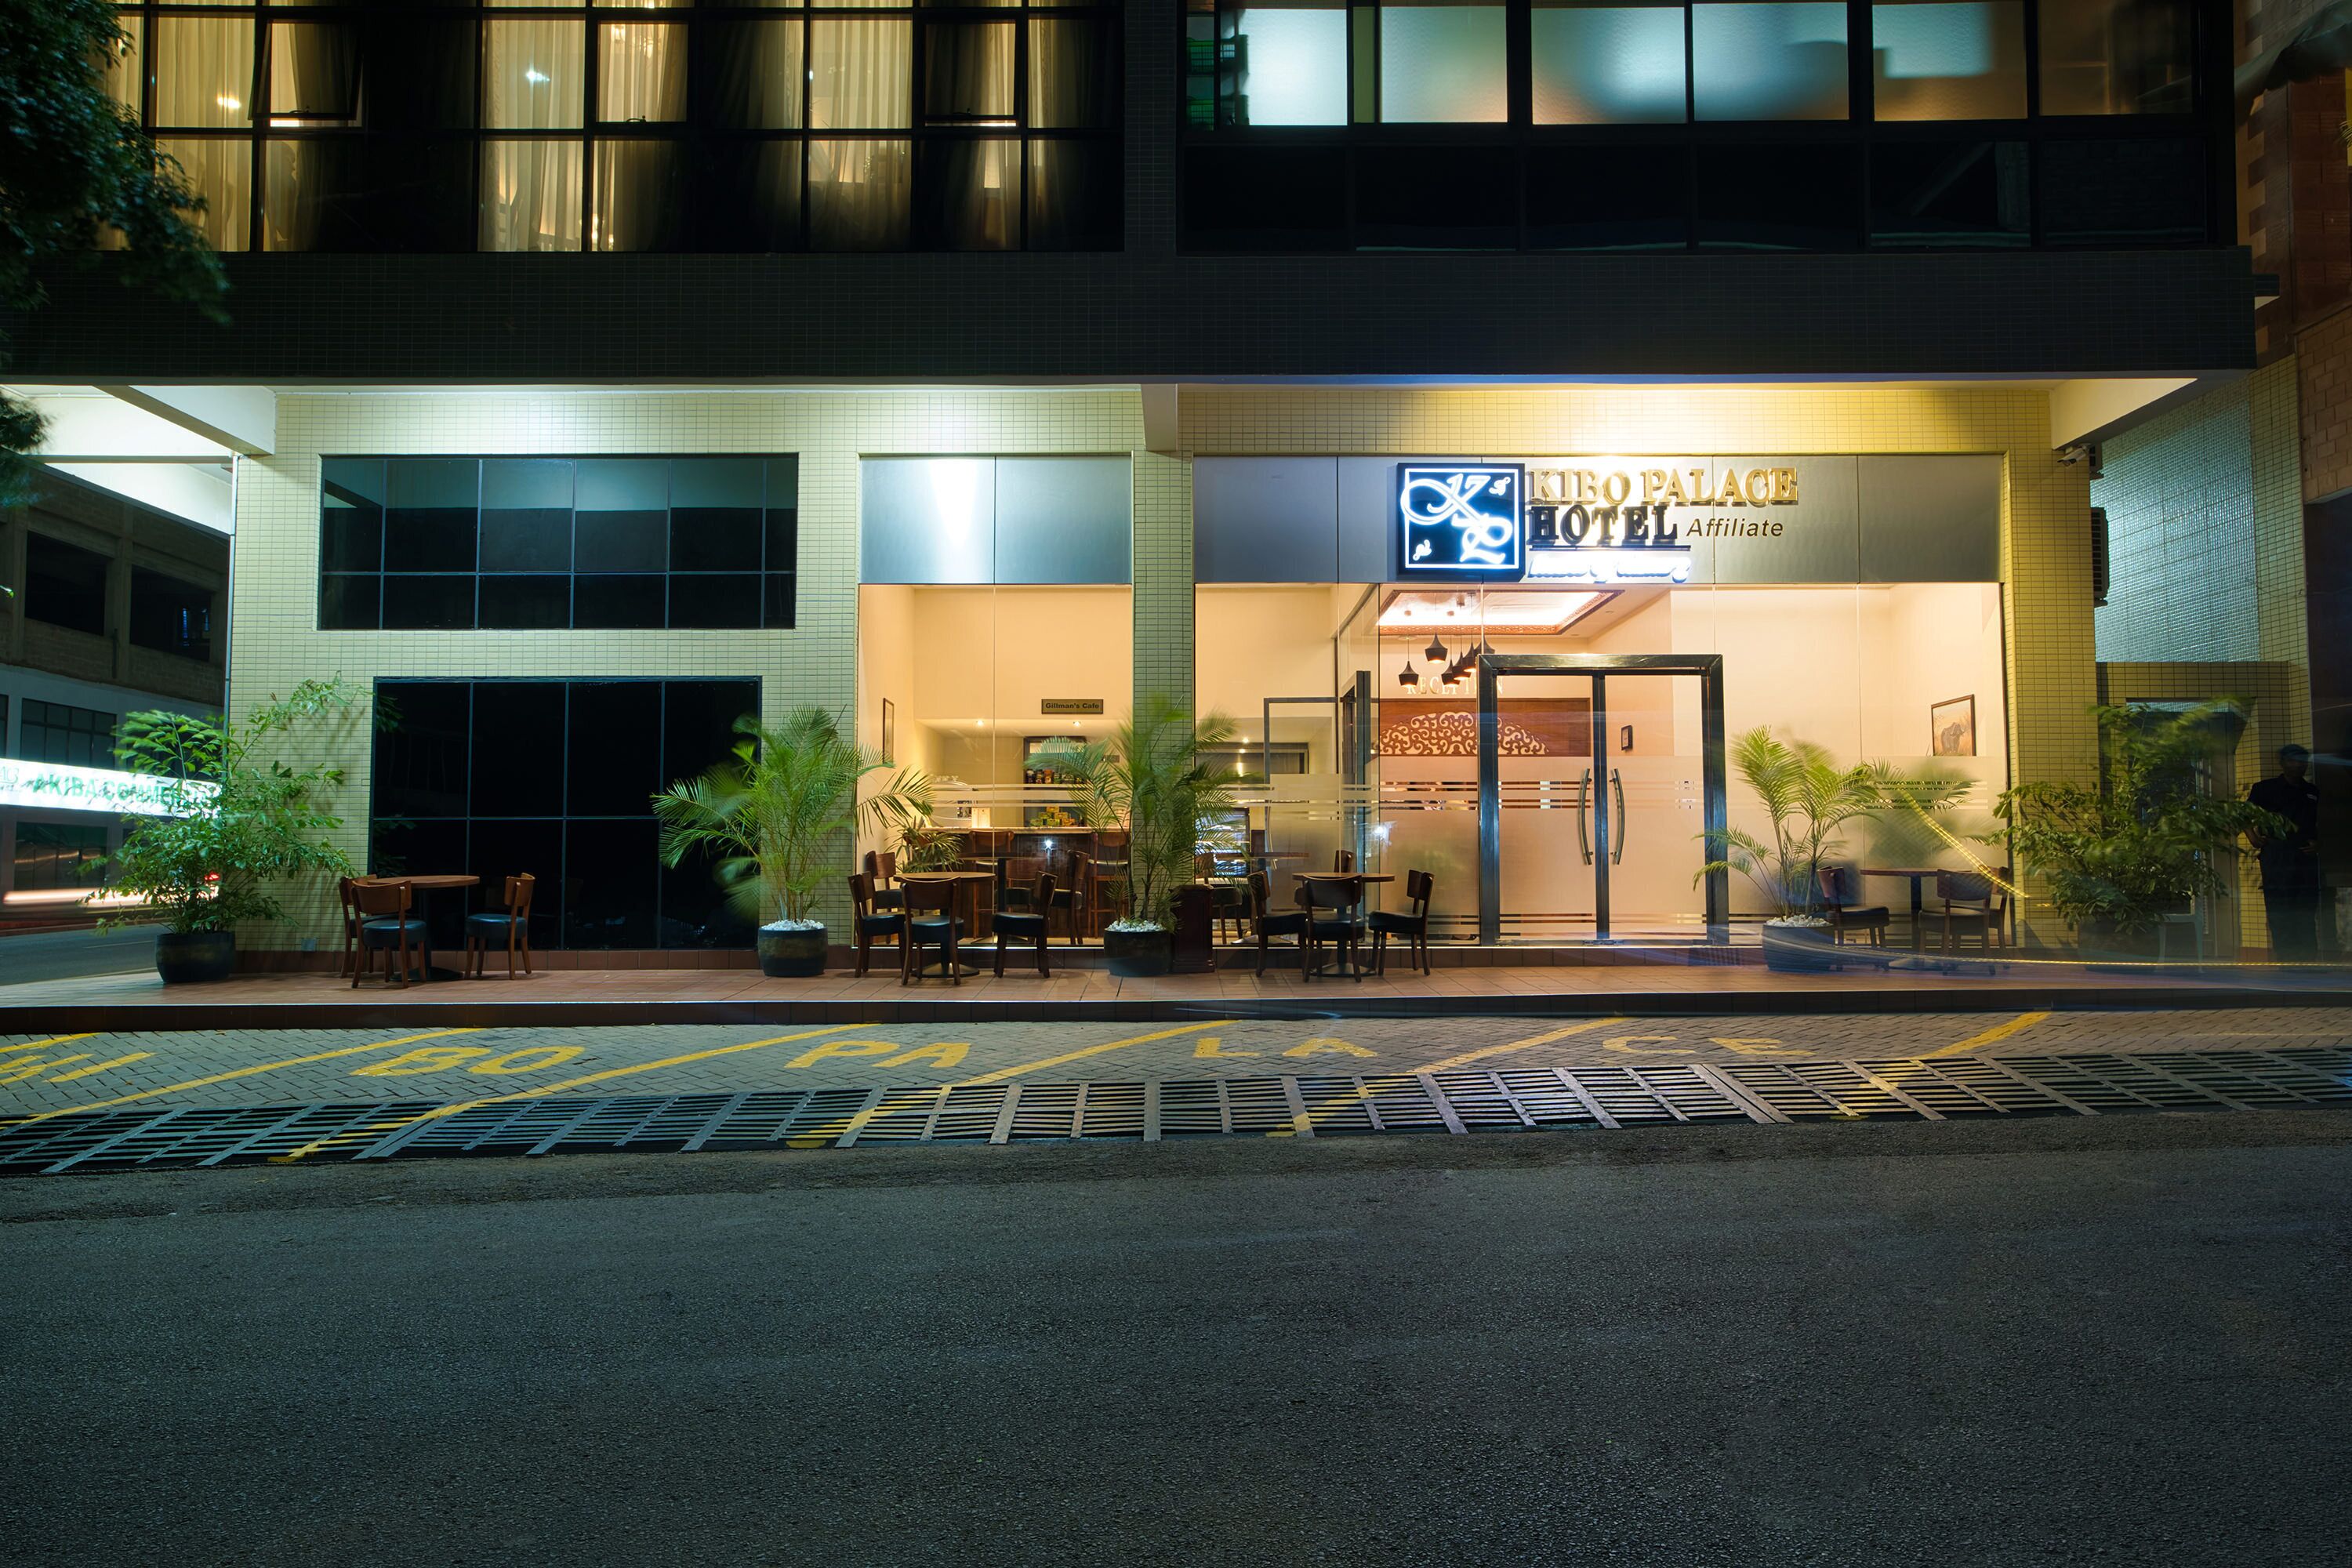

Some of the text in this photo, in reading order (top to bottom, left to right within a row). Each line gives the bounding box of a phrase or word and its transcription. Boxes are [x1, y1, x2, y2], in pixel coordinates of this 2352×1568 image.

[1526, 468, 1798, 506] KIBO PALACE
[1526, 504, 1679, 546] HOTEL
[1686, 518, 1784, 537] Affiliate
[1406, 676, 1504, 695] ECETIN
[33, 773, 97, 799] AKIBA
[784, 1040, 971, 1068] PA
